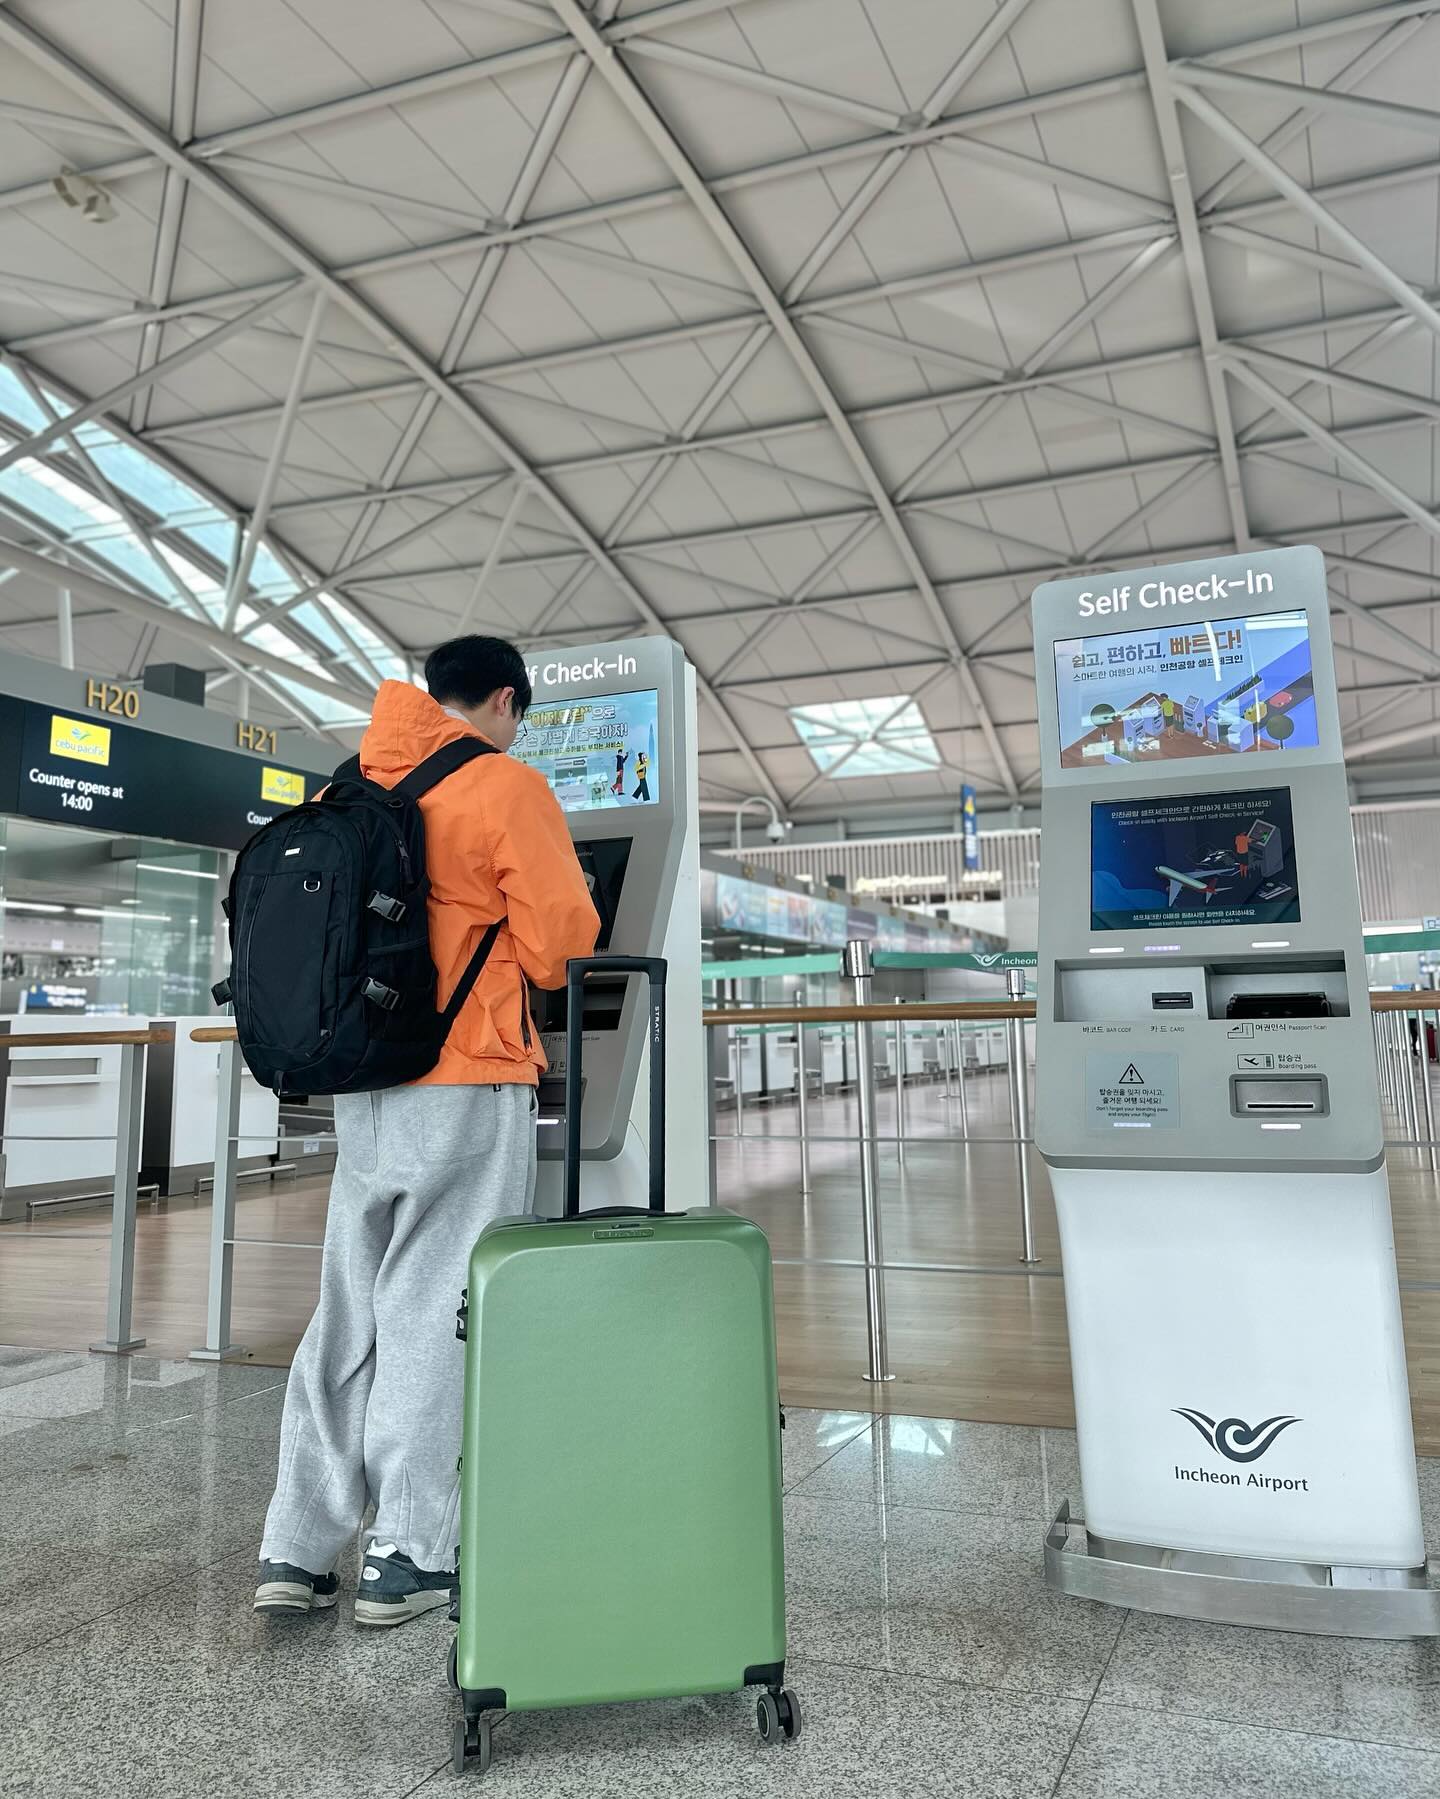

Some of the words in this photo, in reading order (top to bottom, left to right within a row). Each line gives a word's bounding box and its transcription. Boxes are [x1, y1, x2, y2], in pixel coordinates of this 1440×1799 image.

[1078, 587, 1131, 617] Self
[1139, 570, 1274, 609] Check-In
[1072, 654, 1104, 669] 쉽고,
[1106, 641, 1166, 665] 편하고,
[1170, 629, 1243, 656] 빠르다!
[526, 665, 538, 687] lf
[543, 654, 637, 686] Check-In
[1073, 669, 1107, 682] 스마트한
[1108, 666, 1135, 679] 여행의
[1137, 664, 1158, 676] 시작,
[1159, 659, 1196, 673] 인천공항
[87, 679, 140, 719] H20
[237, 720, 278, 755] H21
[29, 768, 76, 790] Counter
[77, 780, 111, 797] opens
[112, 785, 124, 798] at
[61, 792, 93, 812] 14:00
[1256, 1024, 1286, 1032] 여권인식
[1278, 1054, 1302, 1062] 탑승권
[1103, 1097, 1122, 1105] 즐거운
[1124, 1097, 1138, 1105] 여행
[1140, 1097, 1162, 1105] 되세요!
[1175, 1466, 1240, 1485] Incheon
[1247, 1473, 1309, 1491] Airport
